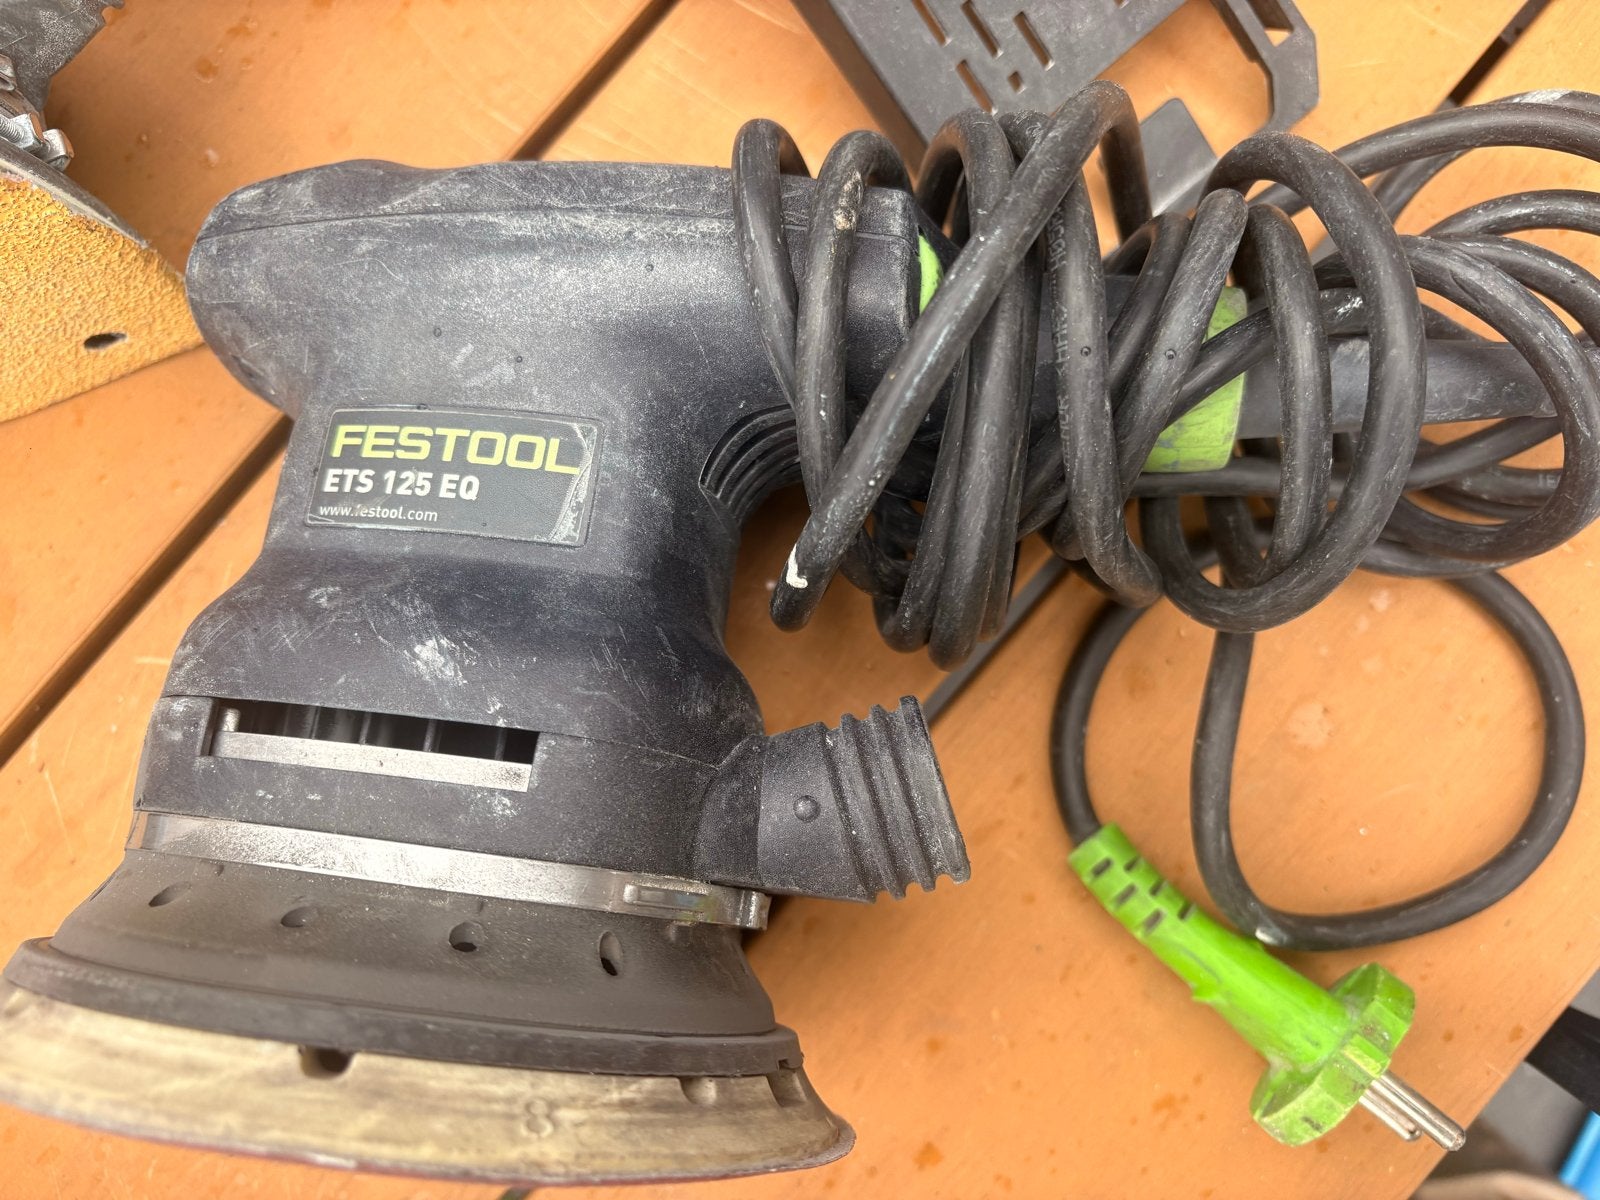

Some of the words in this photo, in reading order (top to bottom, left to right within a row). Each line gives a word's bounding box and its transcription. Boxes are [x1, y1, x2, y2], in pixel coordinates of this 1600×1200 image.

[330, 424, 580, 475] FESTOOL
[322, 468, 375, 494] ETS
[384, 469, 433, 497] 125
[439, 474, 480, 501] EQ
[319, 505, 438, 522] www.festool.com
